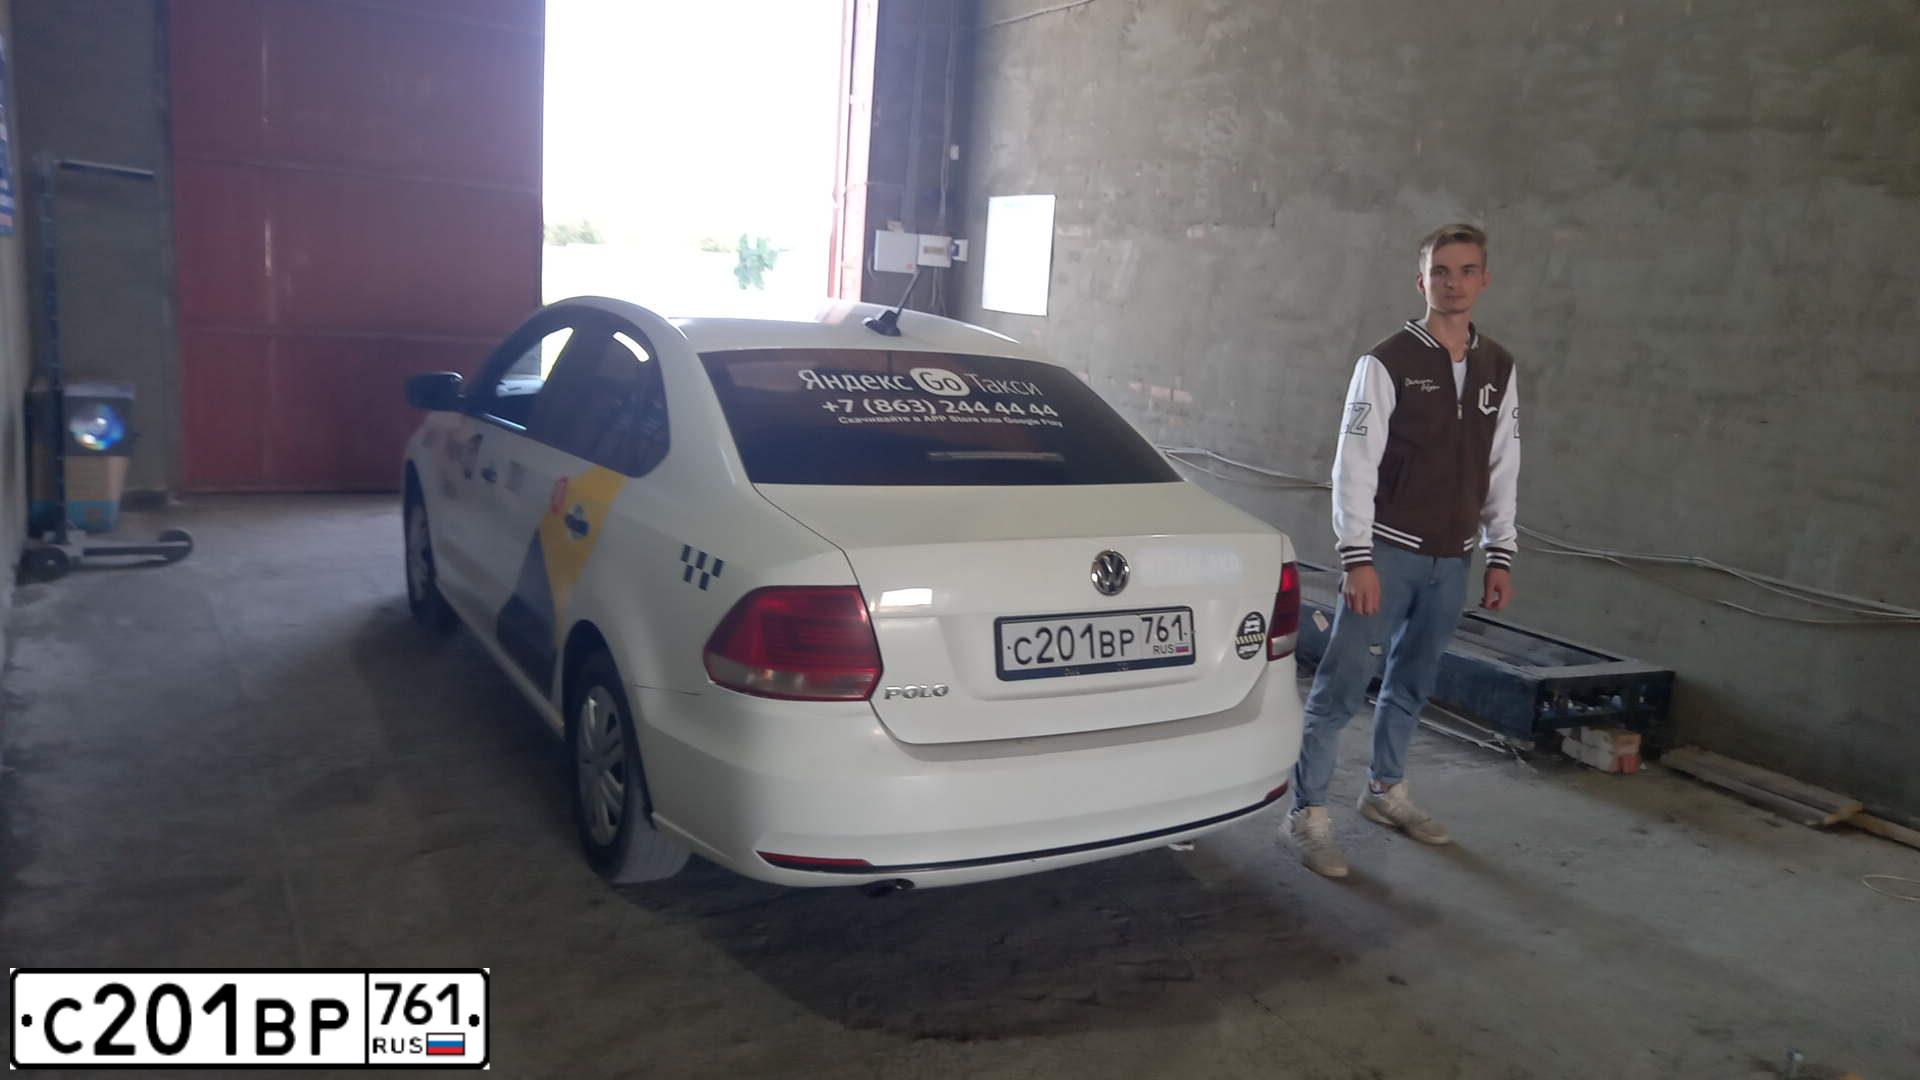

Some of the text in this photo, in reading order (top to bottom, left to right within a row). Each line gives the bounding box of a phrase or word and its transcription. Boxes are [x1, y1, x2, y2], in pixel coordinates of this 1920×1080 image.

[798, 369, 1043, 396] Яндекс Go Такси
[822, 398, 1058, 417] +7 (863) 244 44 44
[838, 416, 911, 424] Скачивайте
[1003, 416, 1040, 426] Google
[1040, 418, 1063, 428] Play
[1141, 614, 1183, 644] 761
[1152, 645, 1174, 655] RUS
[884, 684, 949, 700] POLO
